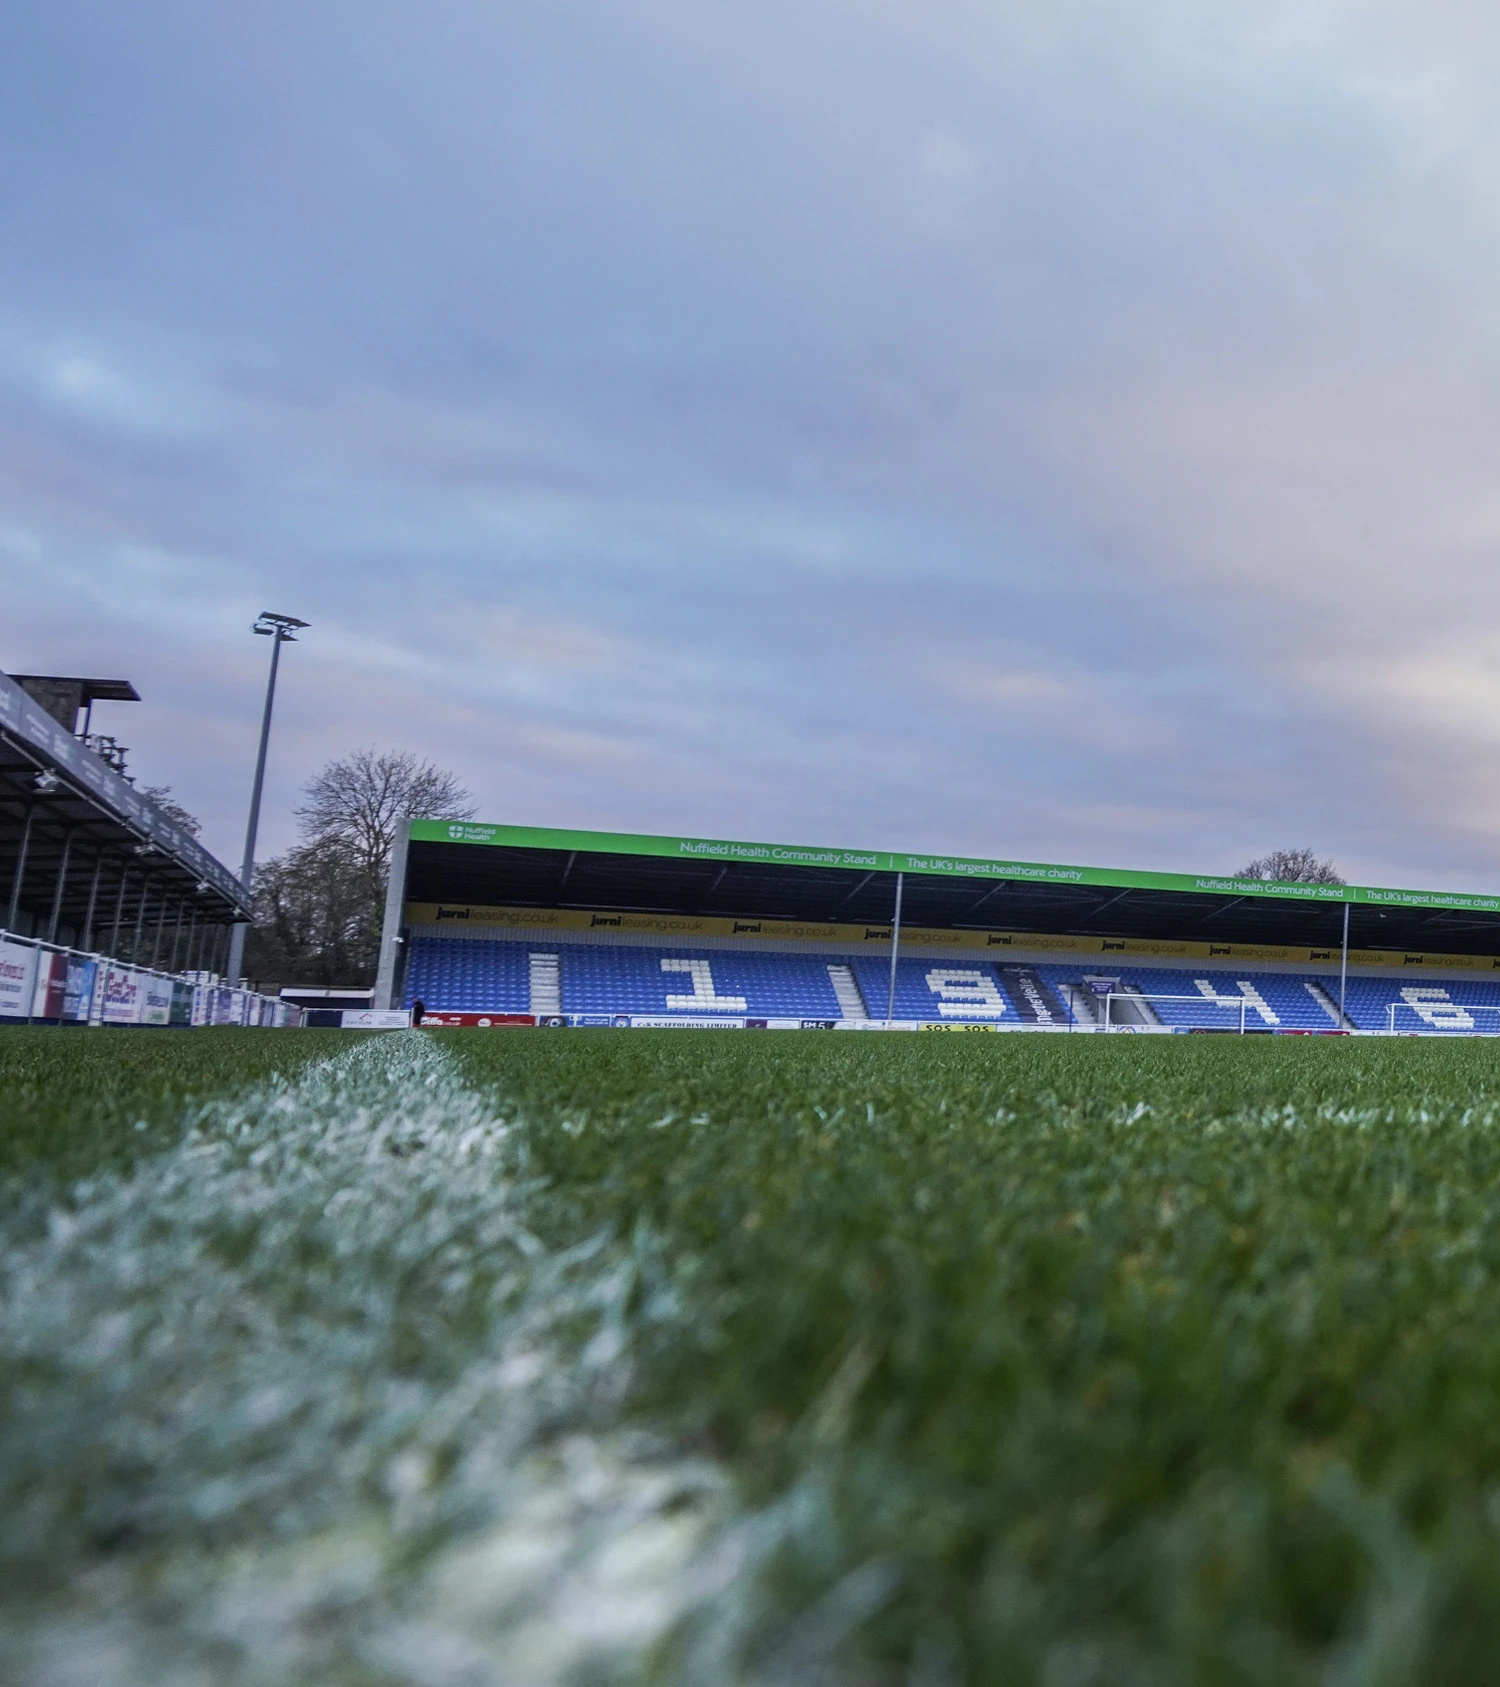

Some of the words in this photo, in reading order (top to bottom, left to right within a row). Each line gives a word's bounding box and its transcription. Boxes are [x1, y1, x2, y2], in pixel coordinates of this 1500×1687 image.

[464, 827, 496, 835] Nuffield
[464, 833, 490, 841] Health
[680, 841, 728, 855] Nuffield
[730, 845, 770, 858] Health
[772, 848, 841, 865] Community
[843, 853, 876, 865] Stand
[907, 857, 927, 869] The
[930, 859, 952, 870] UK's
[955, 861, 990, 874] largest
[992, 863, 1046, 877] healthcare
[1047, 869, 1082, 881] charity
[1196, 879, 1232, 890] Nuffield
[1234, 882, 1263, 892] Health
[1265, 884, 1316, 897] Community
[1318, 887, 1343, 897] Stand
[1366, 890, 1383, 900] The
[1384, 891, 1401, 901] UK's
[1402, 893, 1430, 904] largest
[1431, 894, 1472, 906] healthcare
[1473, 898, 1500, 909] charity
[803, 1021, 816, 1029] SM
[818, 1021, 826, 1029] 5
